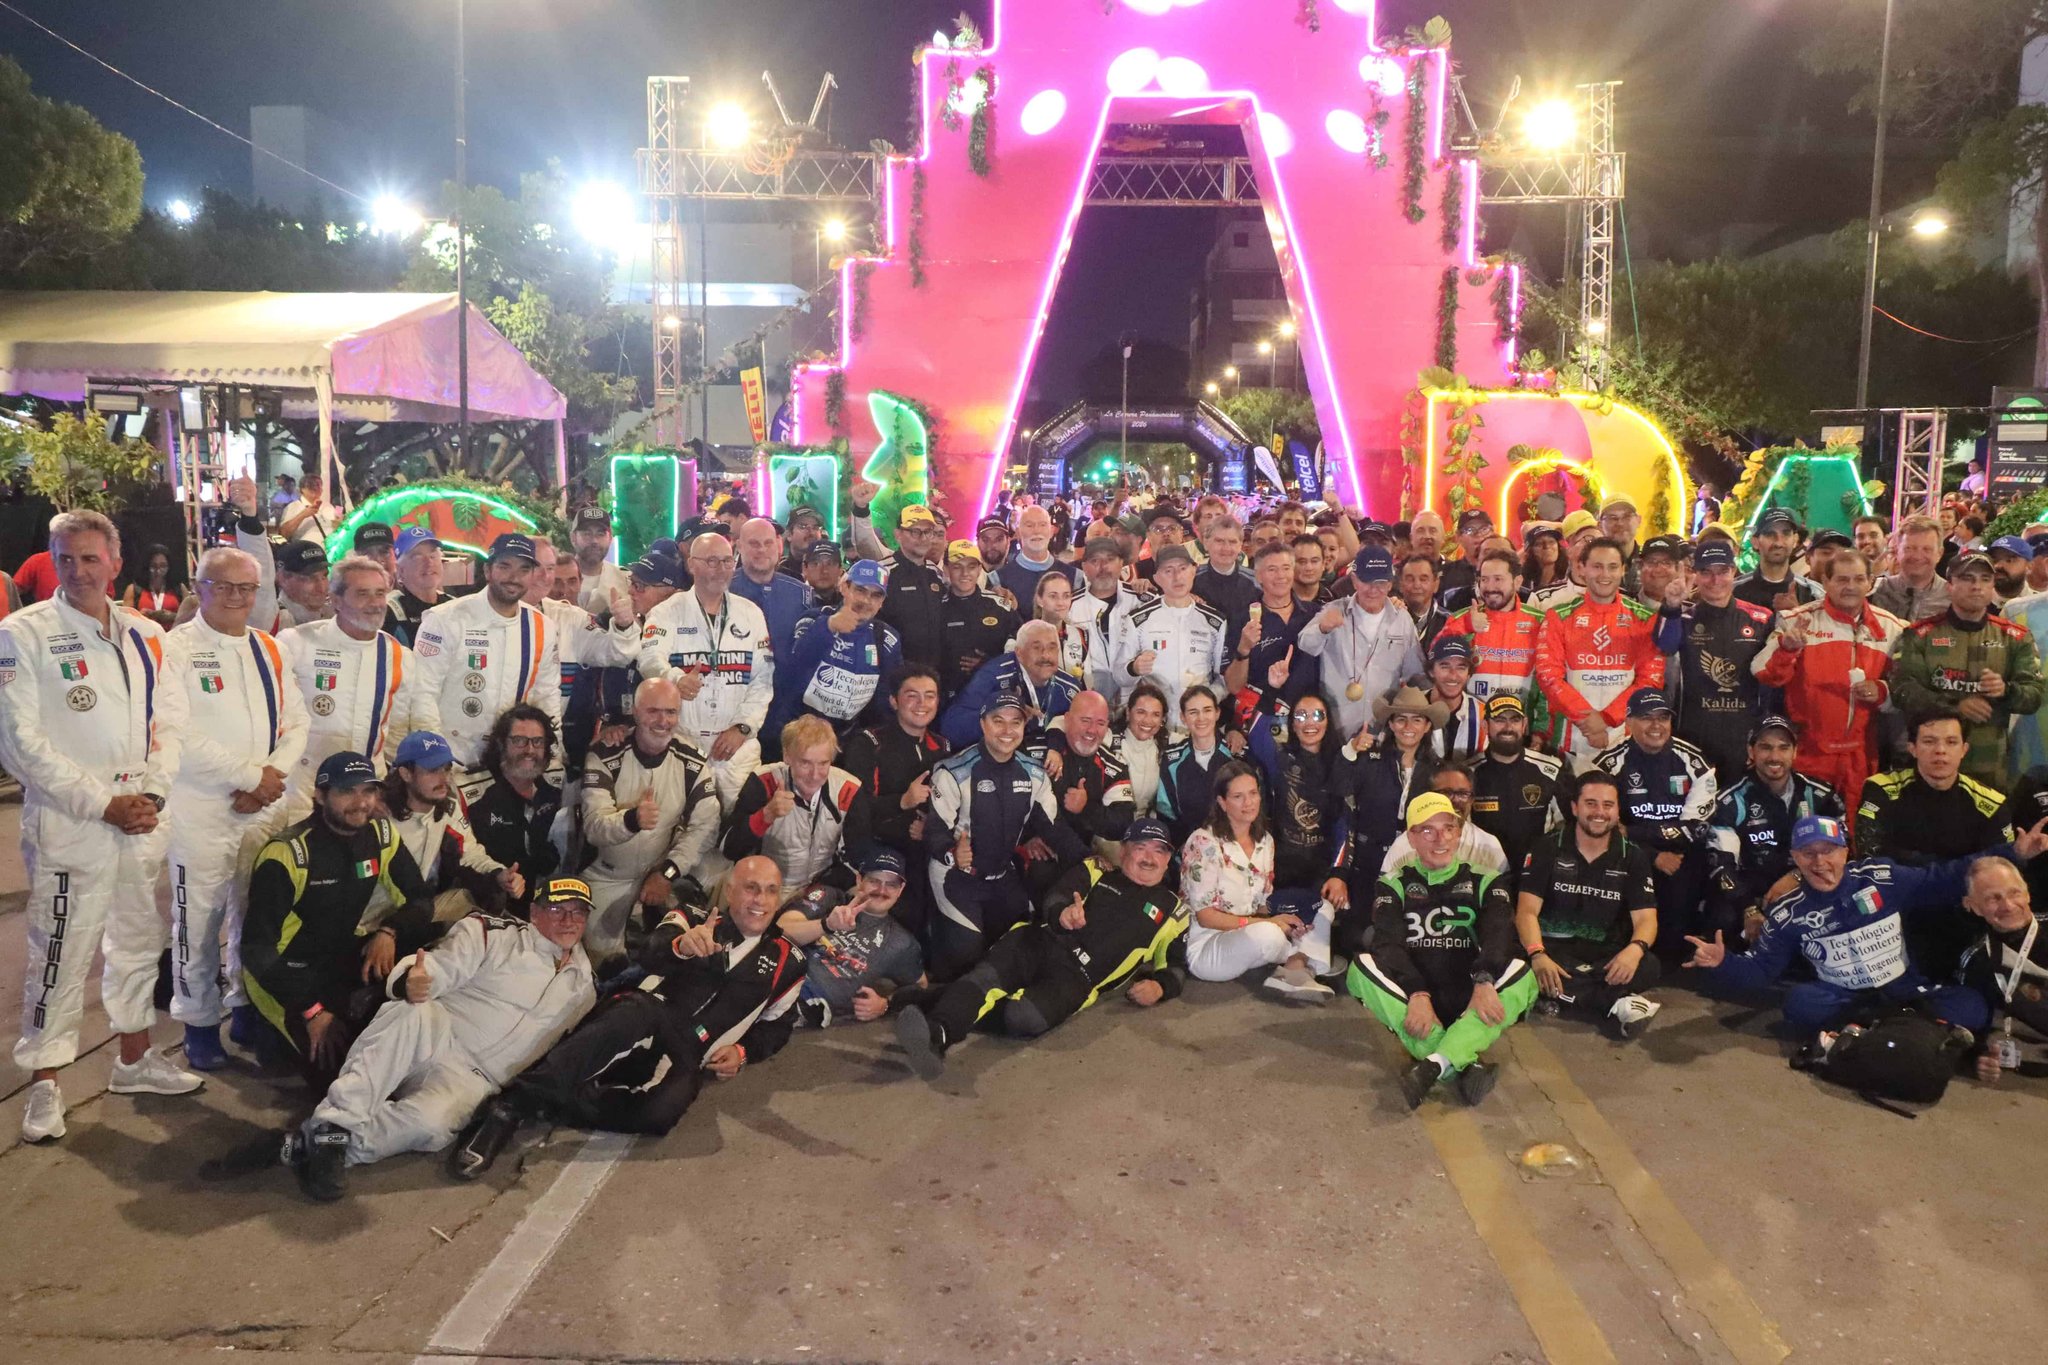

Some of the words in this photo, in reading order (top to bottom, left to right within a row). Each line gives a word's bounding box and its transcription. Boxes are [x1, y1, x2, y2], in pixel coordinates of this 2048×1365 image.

[1056, 420, 1085, 444] CHIAPAS
[1038, 462, 1060, 471] telcel
[1295, 453, 1317, 494] telcel
[1577, 653, 1627, 665] SOLDIE
[1582, 674, 1624, 682] CARNOT
[1702, 697, 1747, 709] Kalida
[1656, 804, 1684, 815] JUST
[1749, 830, 1775, 842] DON
[1554, 882, 1621, 900] SCHAEFFLER
[176, 864, 191, 998] PORSCHE
[1827, 921, 1895, 950] Tecnológico
[33, 872, 69, 1030] PORSCHE
[1833, 951, 1847, 962] de
